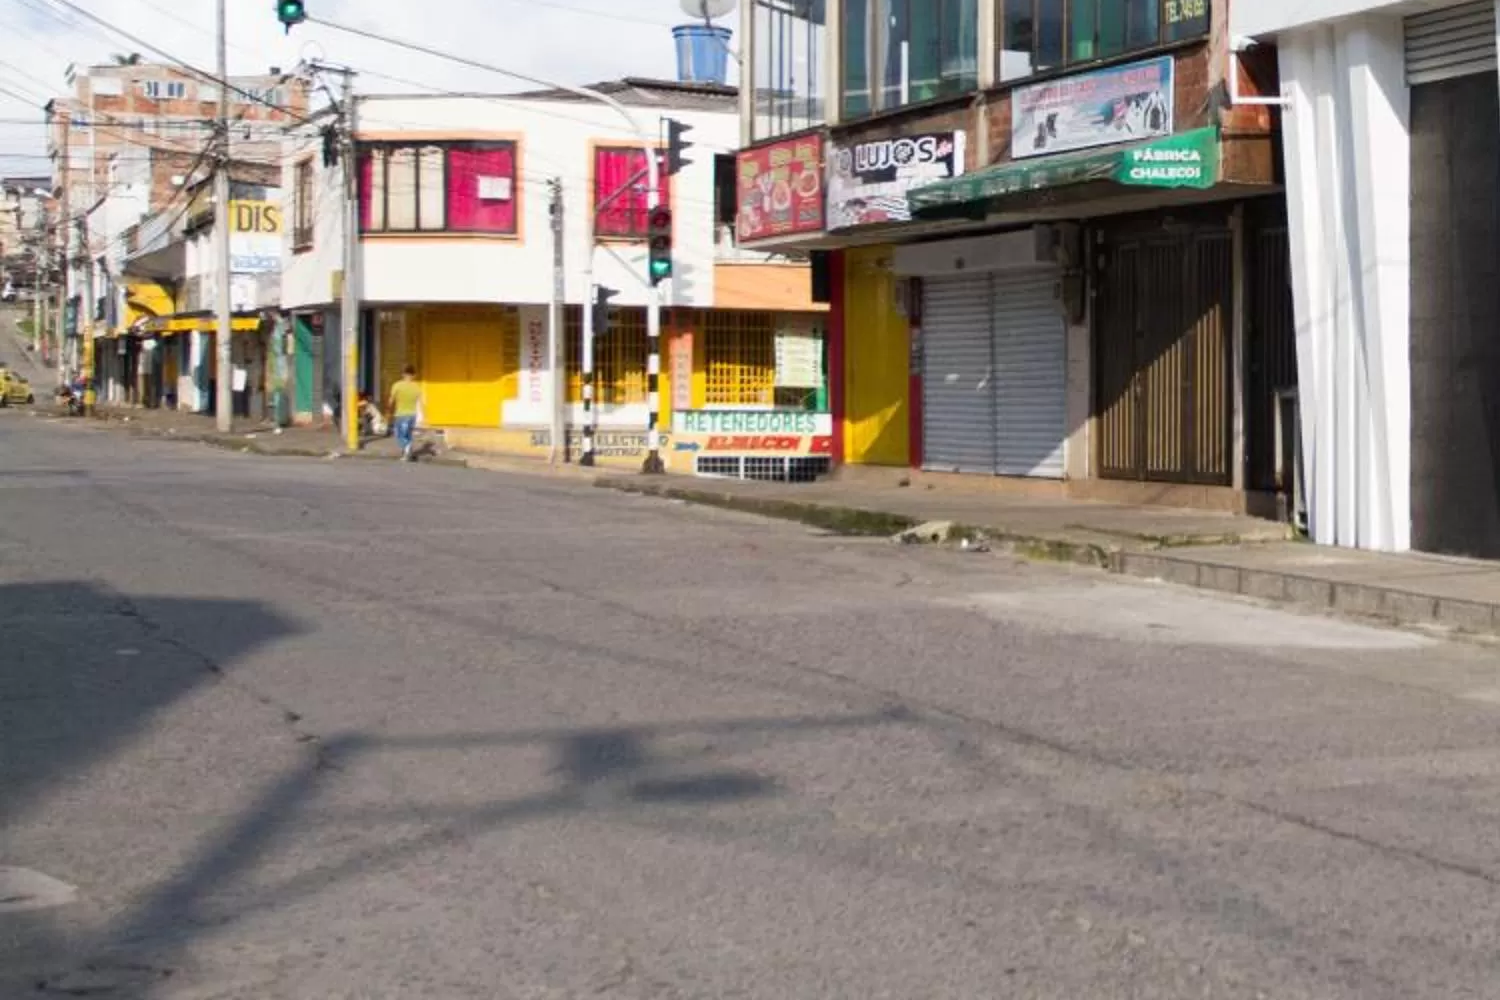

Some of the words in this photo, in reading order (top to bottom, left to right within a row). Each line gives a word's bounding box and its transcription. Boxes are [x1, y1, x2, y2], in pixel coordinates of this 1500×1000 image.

[856, 136, 937, 171] LUJOS
[1133, 148, 1201, 162] FÁBRICA
[236, 204, 279, 232] DIS
[683, 411, 817, 432] RETENEDORES
